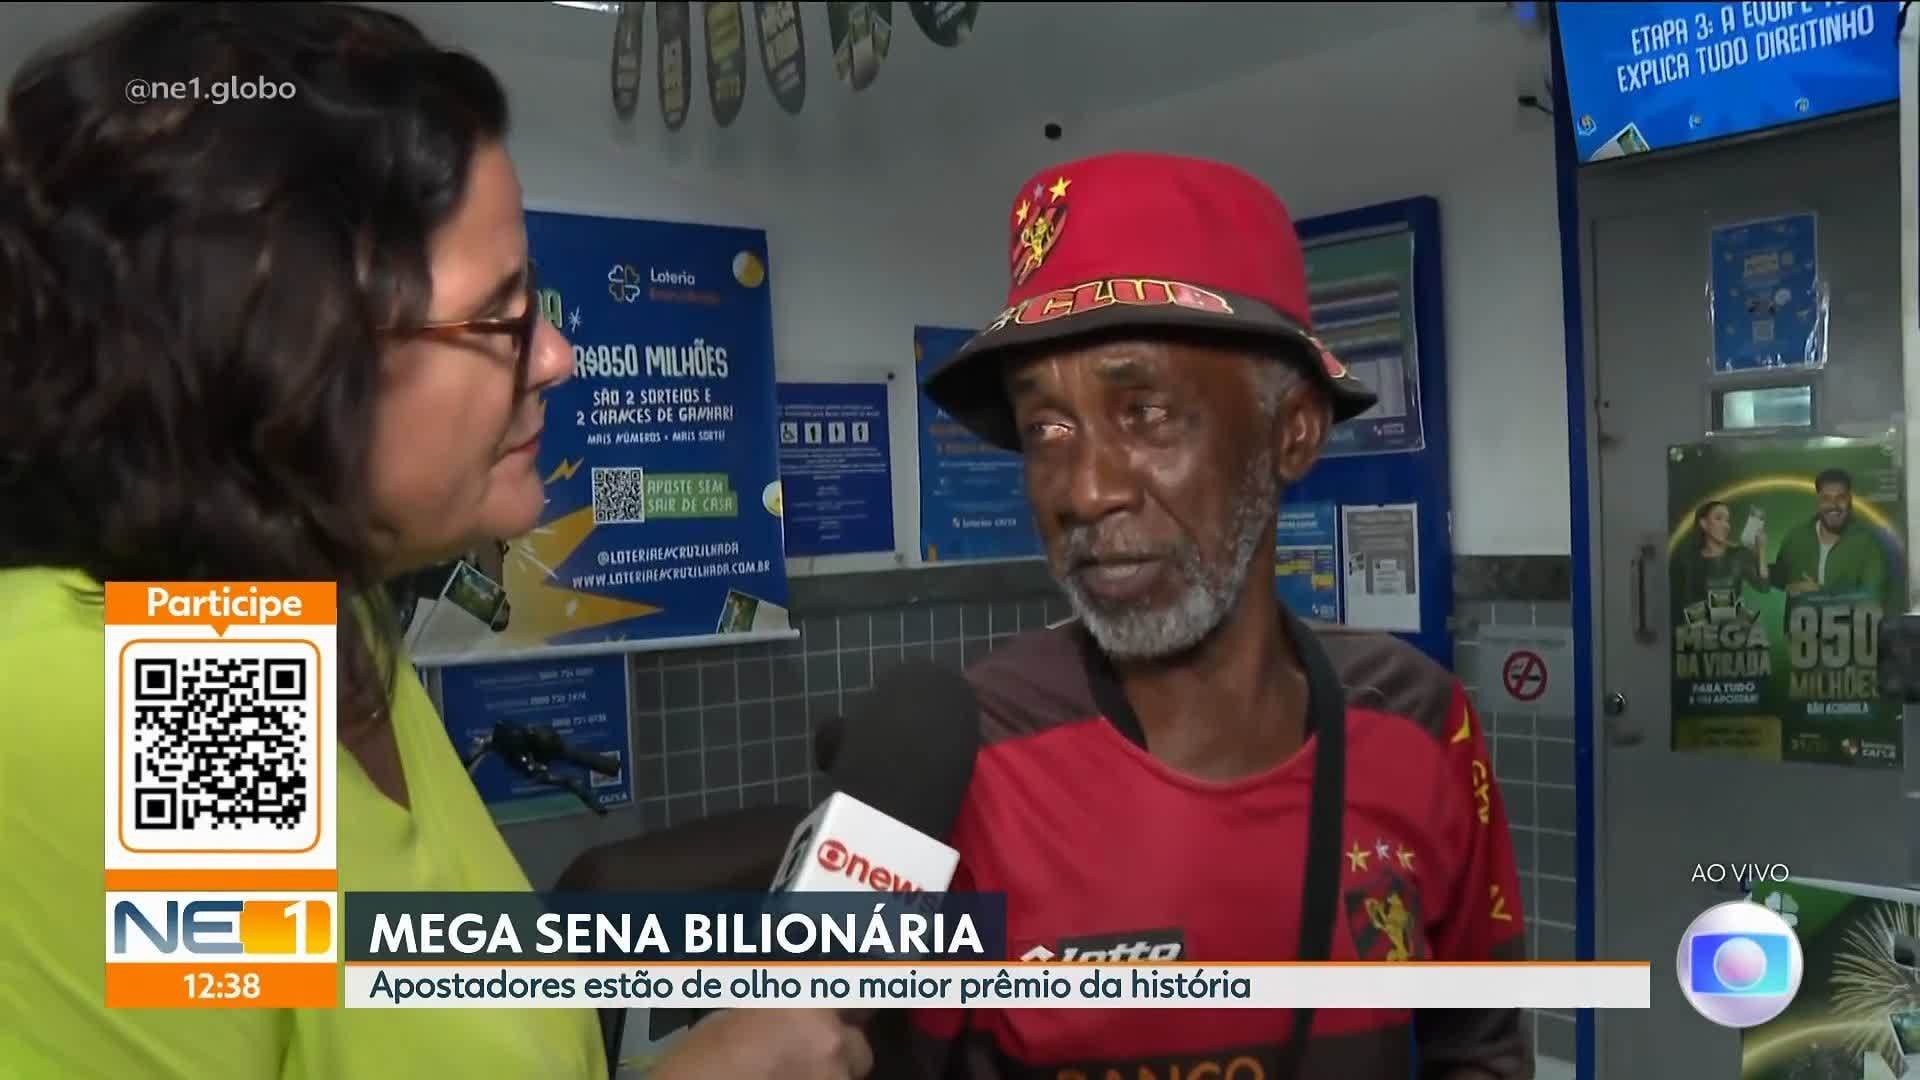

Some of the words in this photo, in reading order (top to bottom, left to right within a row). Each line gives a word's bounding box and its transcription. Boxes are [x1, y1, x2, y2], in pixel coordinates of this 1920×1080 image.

[1632, 18, 1688, 56] ETAPA
[1695, 14, 1714, 41] 3:
[1721, 5, 1735, 35] A
[1617, 54, 1690, 93] EXPLICA
[1696, 37, 1748, 75] TUDO
[1756, 4, 1874, 61] DIREITINHO
[650, 267, 695, 286] Loteria
[573, 344, 637, 379] R$850
[645, 339, 728, 379] MILHÕES
[593, 387, 619, 406] SÃO
[626, 390, 635, 405] 2
[640, 388, 700, 405] SORTEIOS
[705, 388, 711, 403] E
[576, 412, 585, 426] 2
[590, 408, 652, 425] CHANCES
[657, 407, 673, 422] DE
[679, 405, 734, 422] GANHAR!
[587, 432, 611, 445] MAIS
[615, 431, 661, 444] NÚMEROS
[672, 431, 695, 442] MAIS
[648, 480, 692, 495] APOSTE
[698, 478, 723, 493] SEM
[648, 498, 679, 513] SAIR
[682, 498, 697, 512] DE
[703, 497, 733, 511] CASA
[597, 542, 739, 566] @LOTERIAENCRUZILHADA
[572, 560, 770, 589] WWW.LOTERIAENCRUZILHADA.COM.BR
[1676, 622, 1770, 653] MEGA
[1789, 605, 1882, 669] 850
